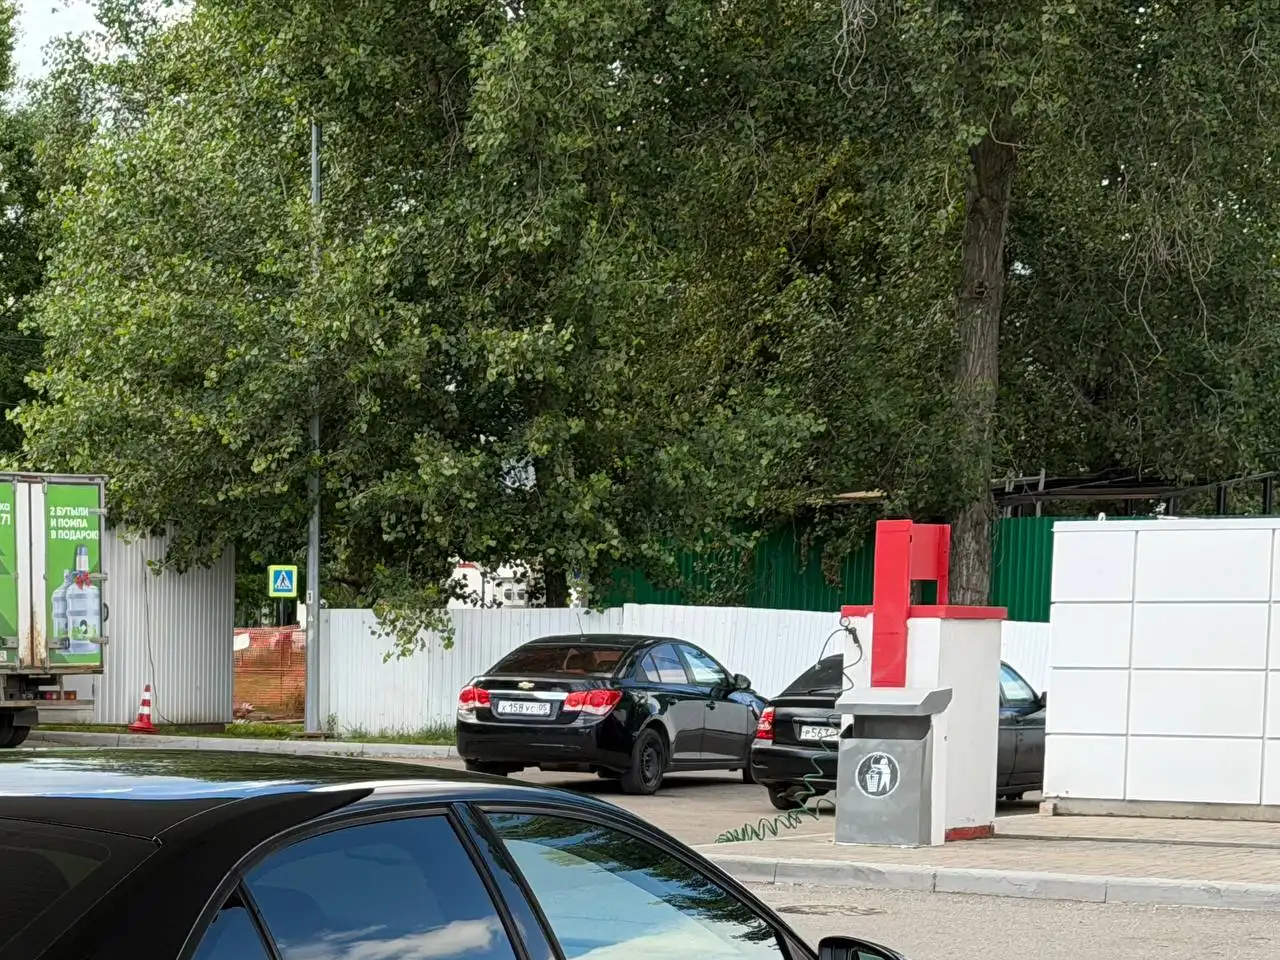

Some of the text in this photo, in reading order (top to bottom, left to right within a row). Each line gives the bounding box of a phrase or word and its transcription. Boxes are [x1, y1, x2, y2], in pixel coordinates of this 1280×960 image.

[49, 506, 89, 517] 2 БУТЫЛИ
[0, 513, 11, 526] 71
[50, 518, 89, 528] И ПОМПА
[50, 530, 57, 540] В
